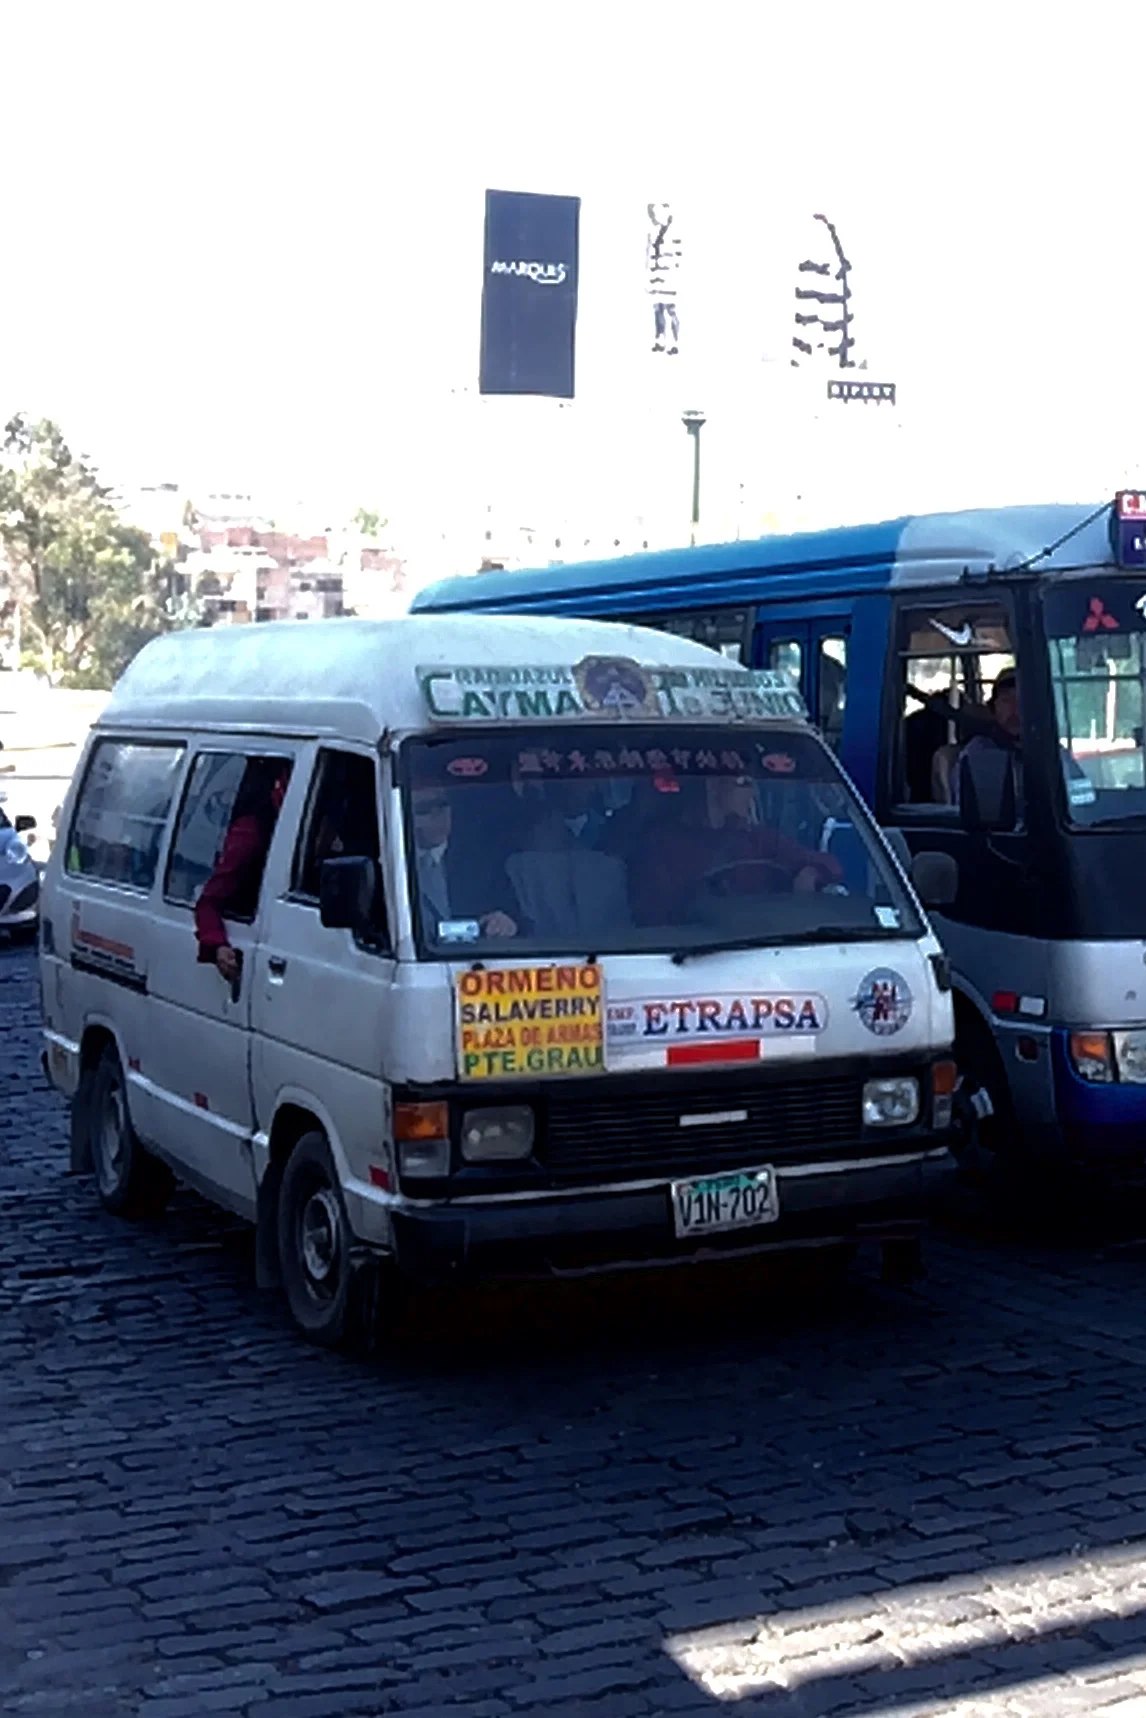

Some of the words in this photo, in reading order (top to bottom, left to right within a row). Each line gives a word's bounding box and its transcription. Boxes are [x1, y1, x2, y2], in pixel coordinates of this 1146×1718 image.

[491, 260, 568, 284] MARQUIS
[422, 673, 584, 717] CAYMA
[461, 996, 601, 1023] SALAVERRY
[642, 998, 820, 1036] ETRAPSA
[463, 1028, 516, 1049] PLAZA
[520, 1026, 543, 1046] DE
[547, 1022, 602, 1044] ARMAS
